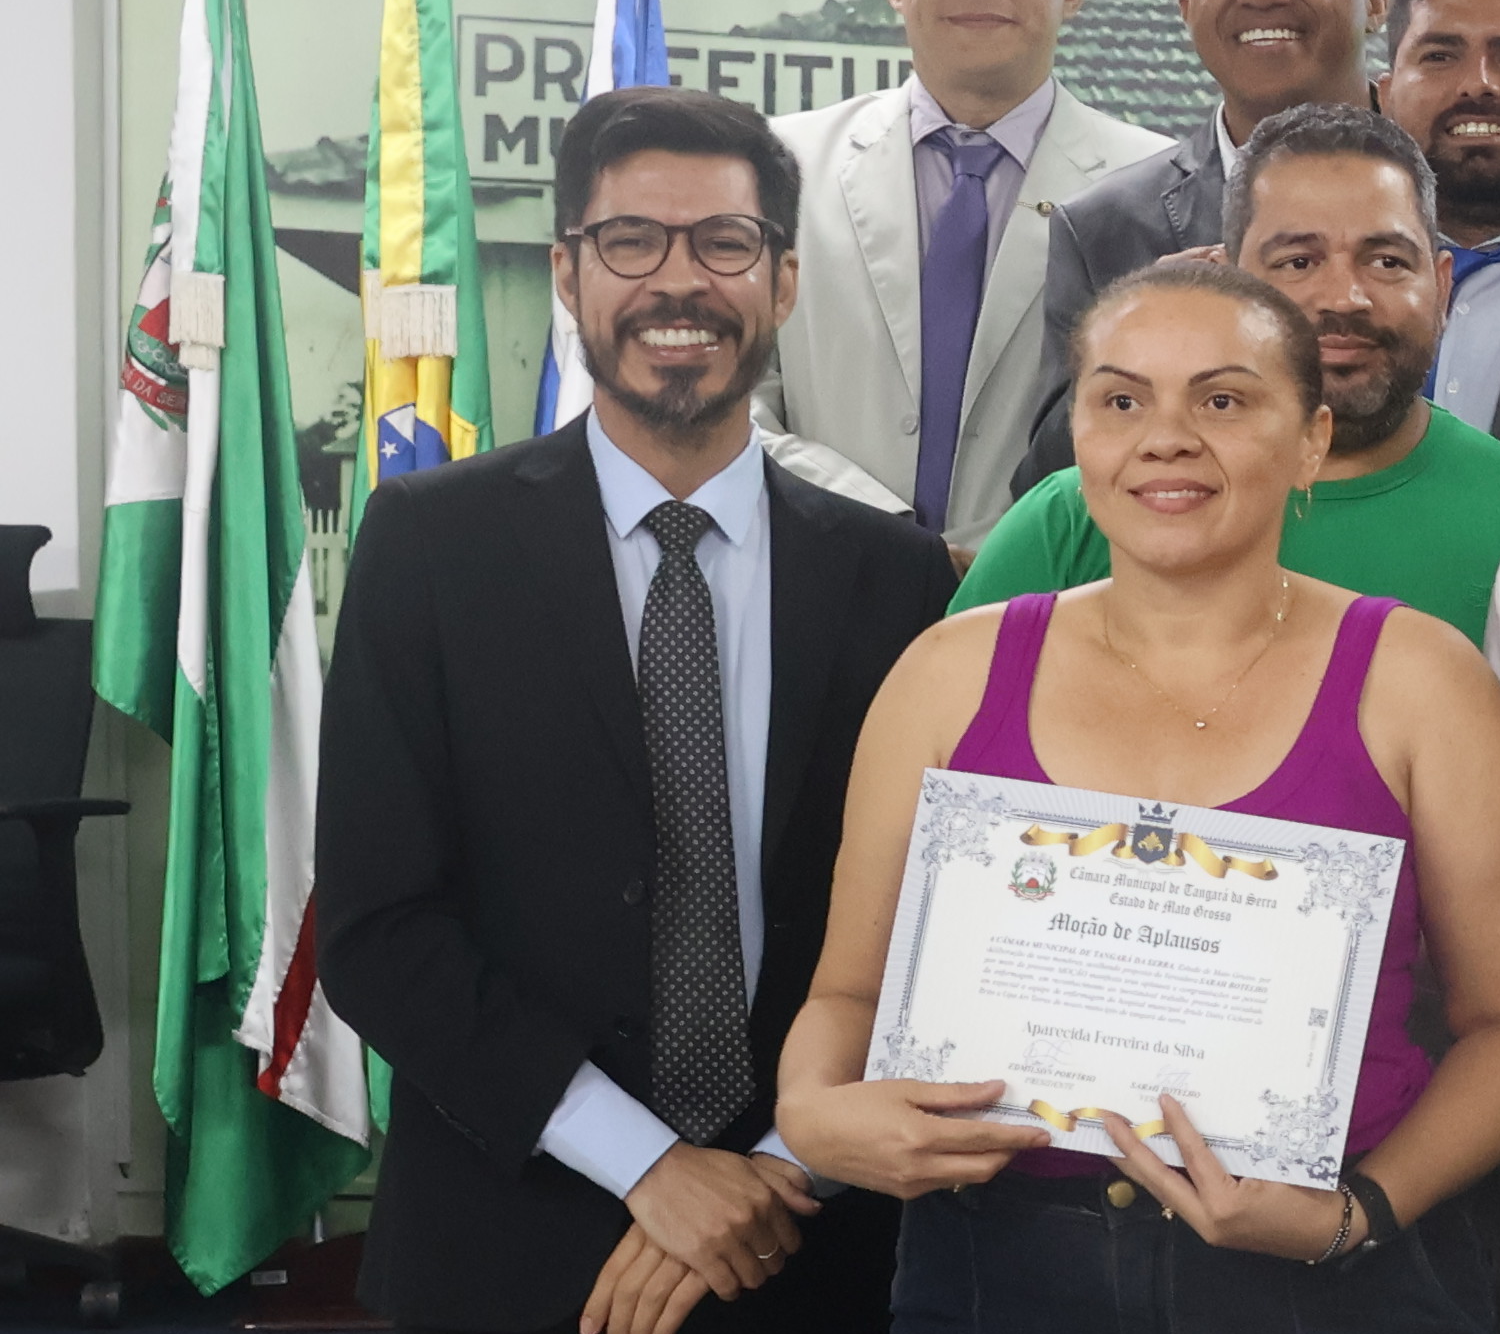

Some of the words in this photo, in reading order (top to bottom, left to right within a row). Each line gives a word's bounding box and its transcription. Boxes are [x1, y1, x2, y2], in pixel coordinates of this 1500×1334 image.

[1048, 913, 1107, 938] Moção
[1113, 922, 1132, 940] de
[1137, 925, 1221, 953] Aplausos
[1023, 1021, 1090, 1042] Aparecida
[1094, 1030, 1149, 1051] Ferreira
[1153, 1040, 1169, 1054] da
[1174, 1043, 1204, 1059] Silva
